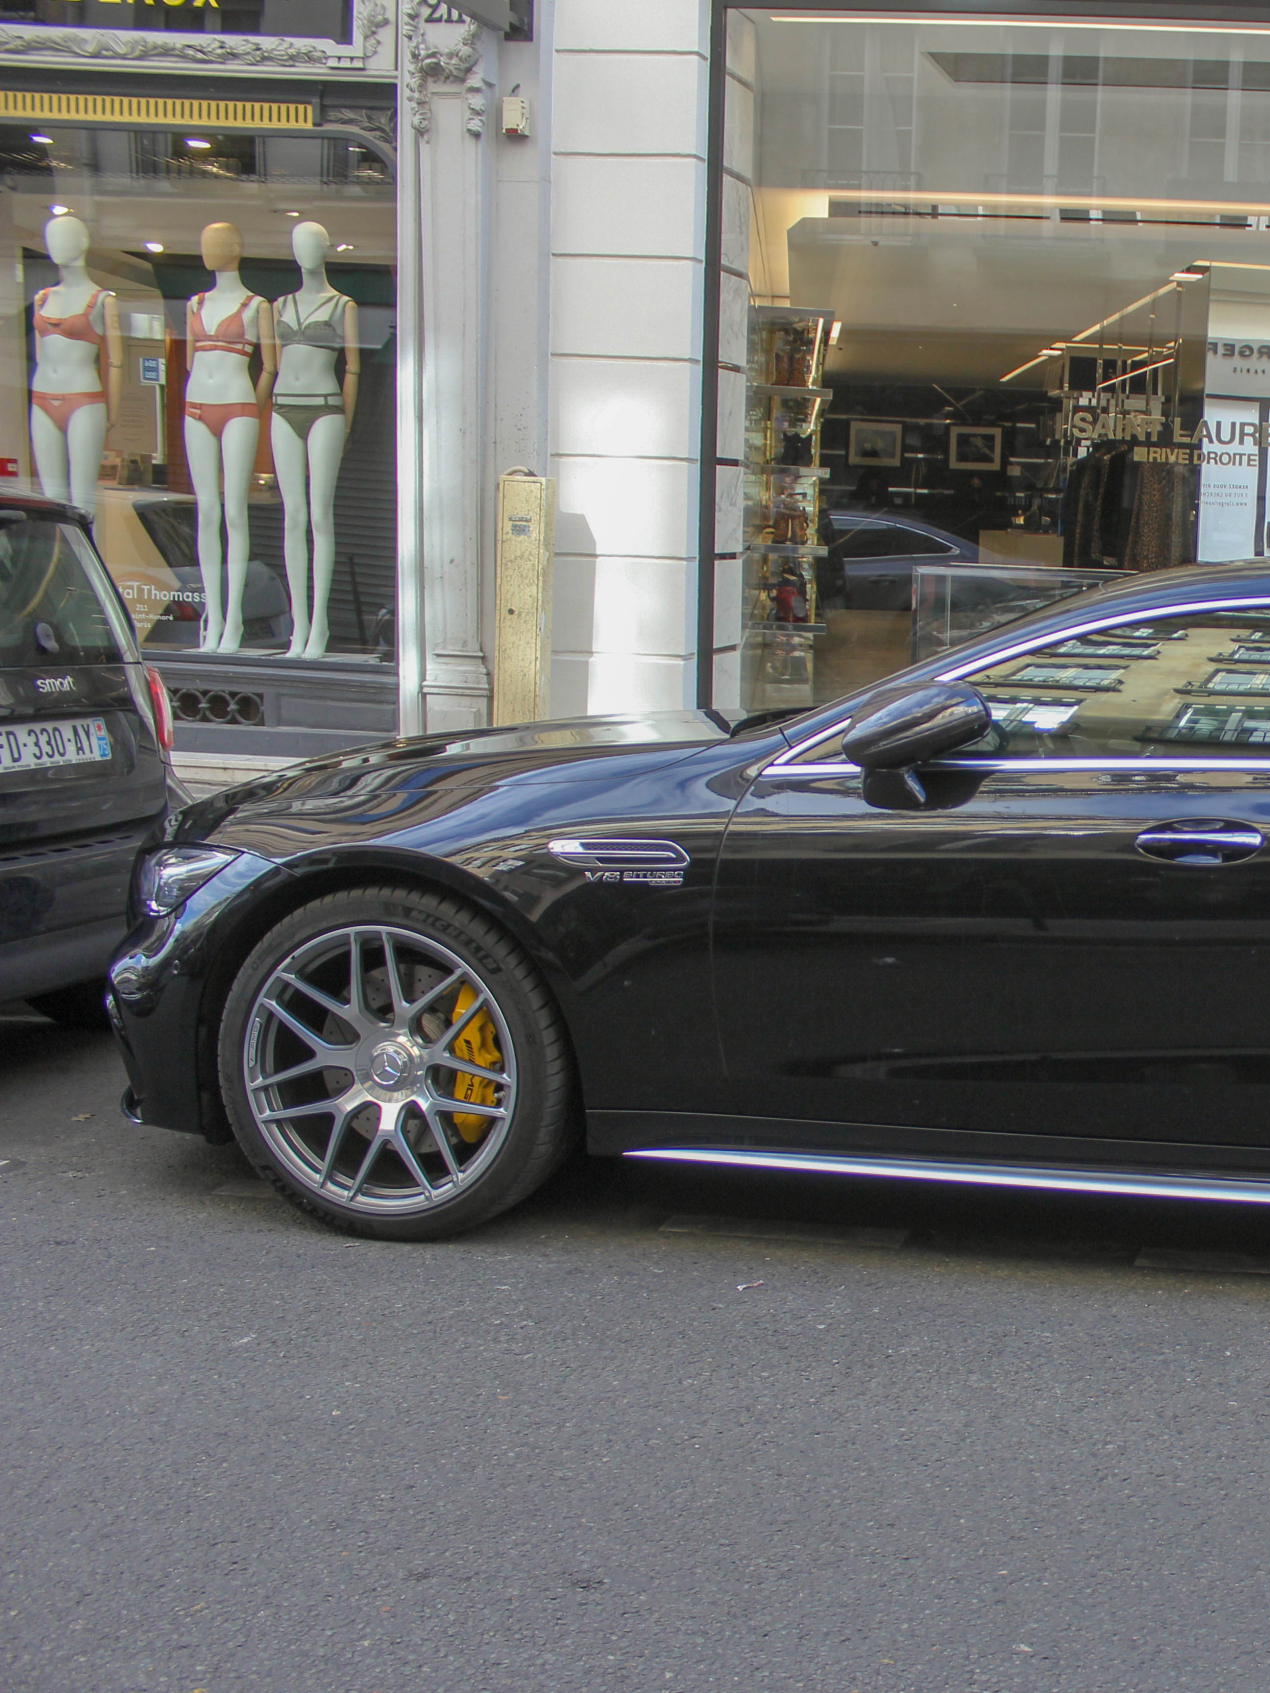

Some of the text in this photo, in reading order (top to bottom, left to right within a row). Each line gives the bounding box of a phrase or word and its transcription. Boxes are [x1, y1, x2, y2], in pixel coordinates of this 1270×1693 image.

[1072, 411, 1166, 442] SAINT
[1148, 446, 1258, 468] RIVE DROITE
[141, 586, 208, 603] Thomass
[135, 603, 149, 612] 211
[36, 675, 77, 693] smart
[584, 871, 684, 882] V8 BITURBO
